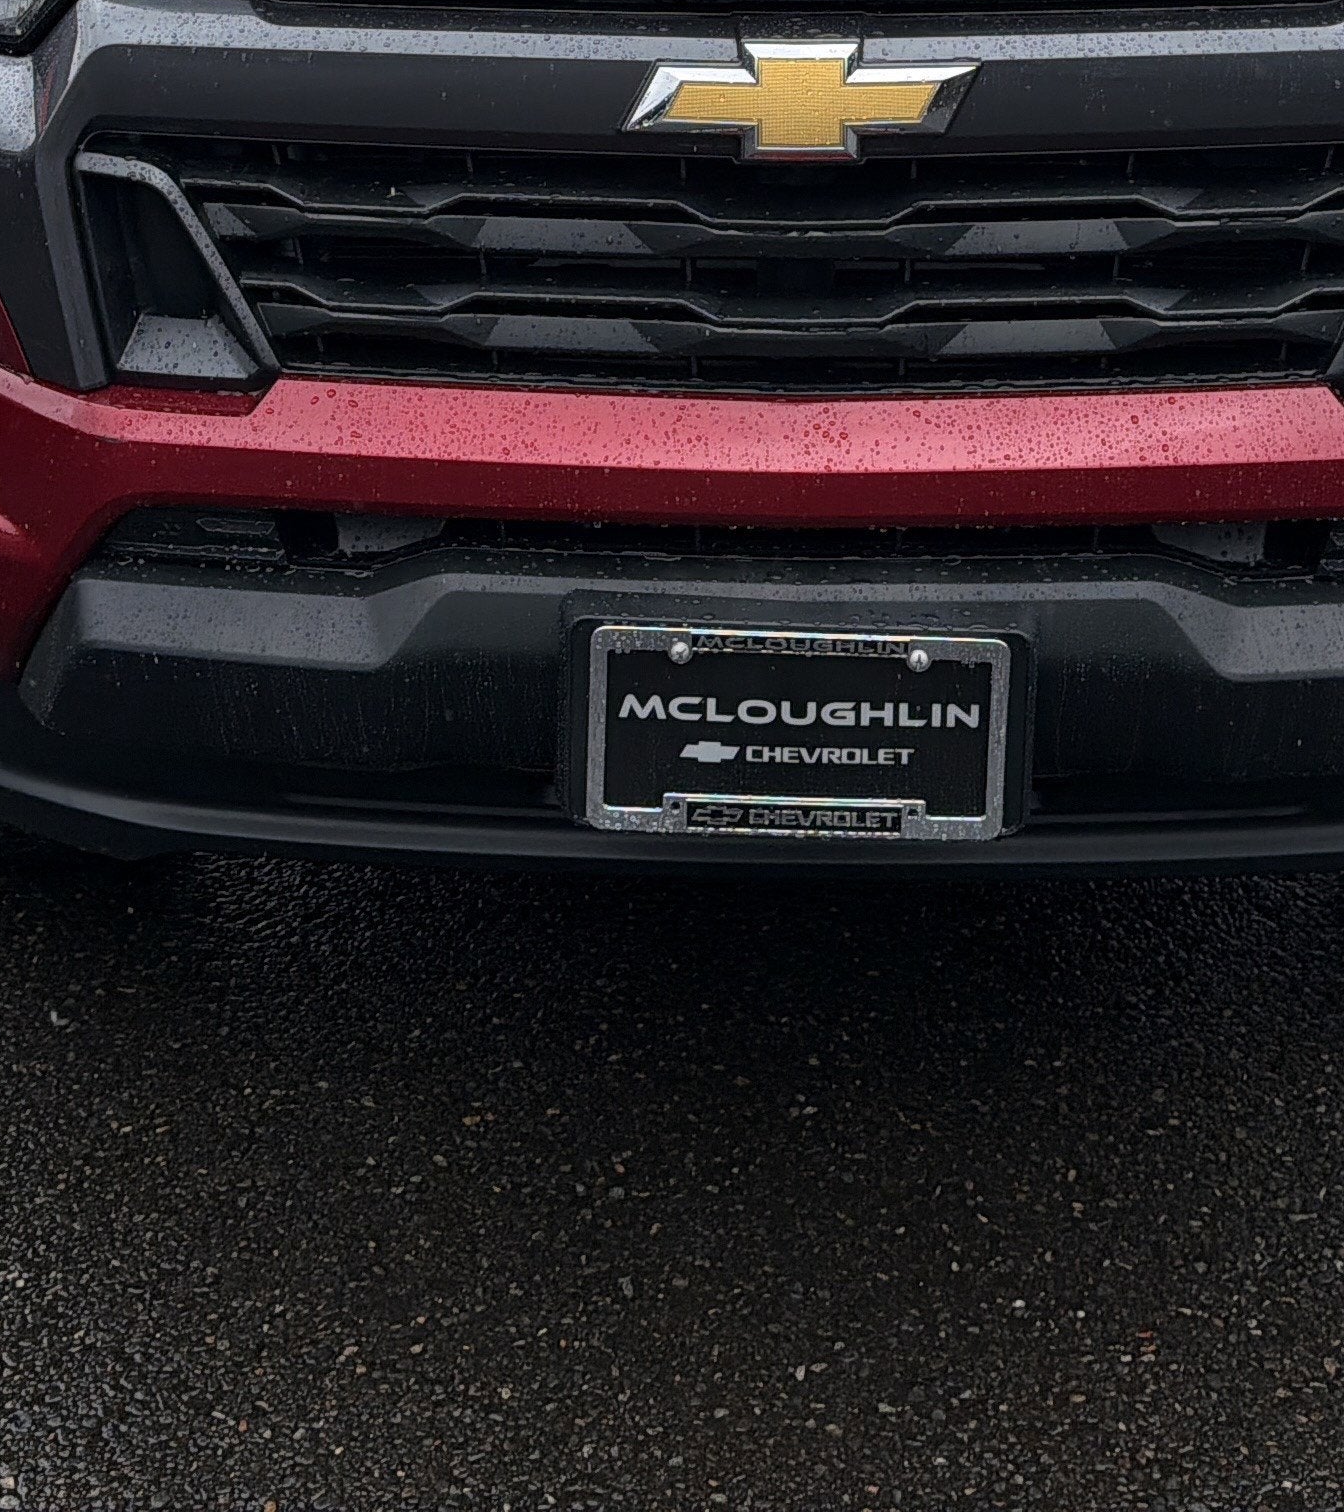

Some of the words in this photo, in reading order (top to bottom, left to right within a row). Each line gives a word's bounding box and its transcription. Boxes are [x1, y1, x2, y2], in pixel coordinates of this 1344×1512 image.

[696, 635, 908, 655] MCLOUGHLIN
[618, 693, 981, 729] MCLOUGHLIN
[745, 744, 915, 765] CHEVROLET
[748, 807, 899, 829] CHEVROLET
